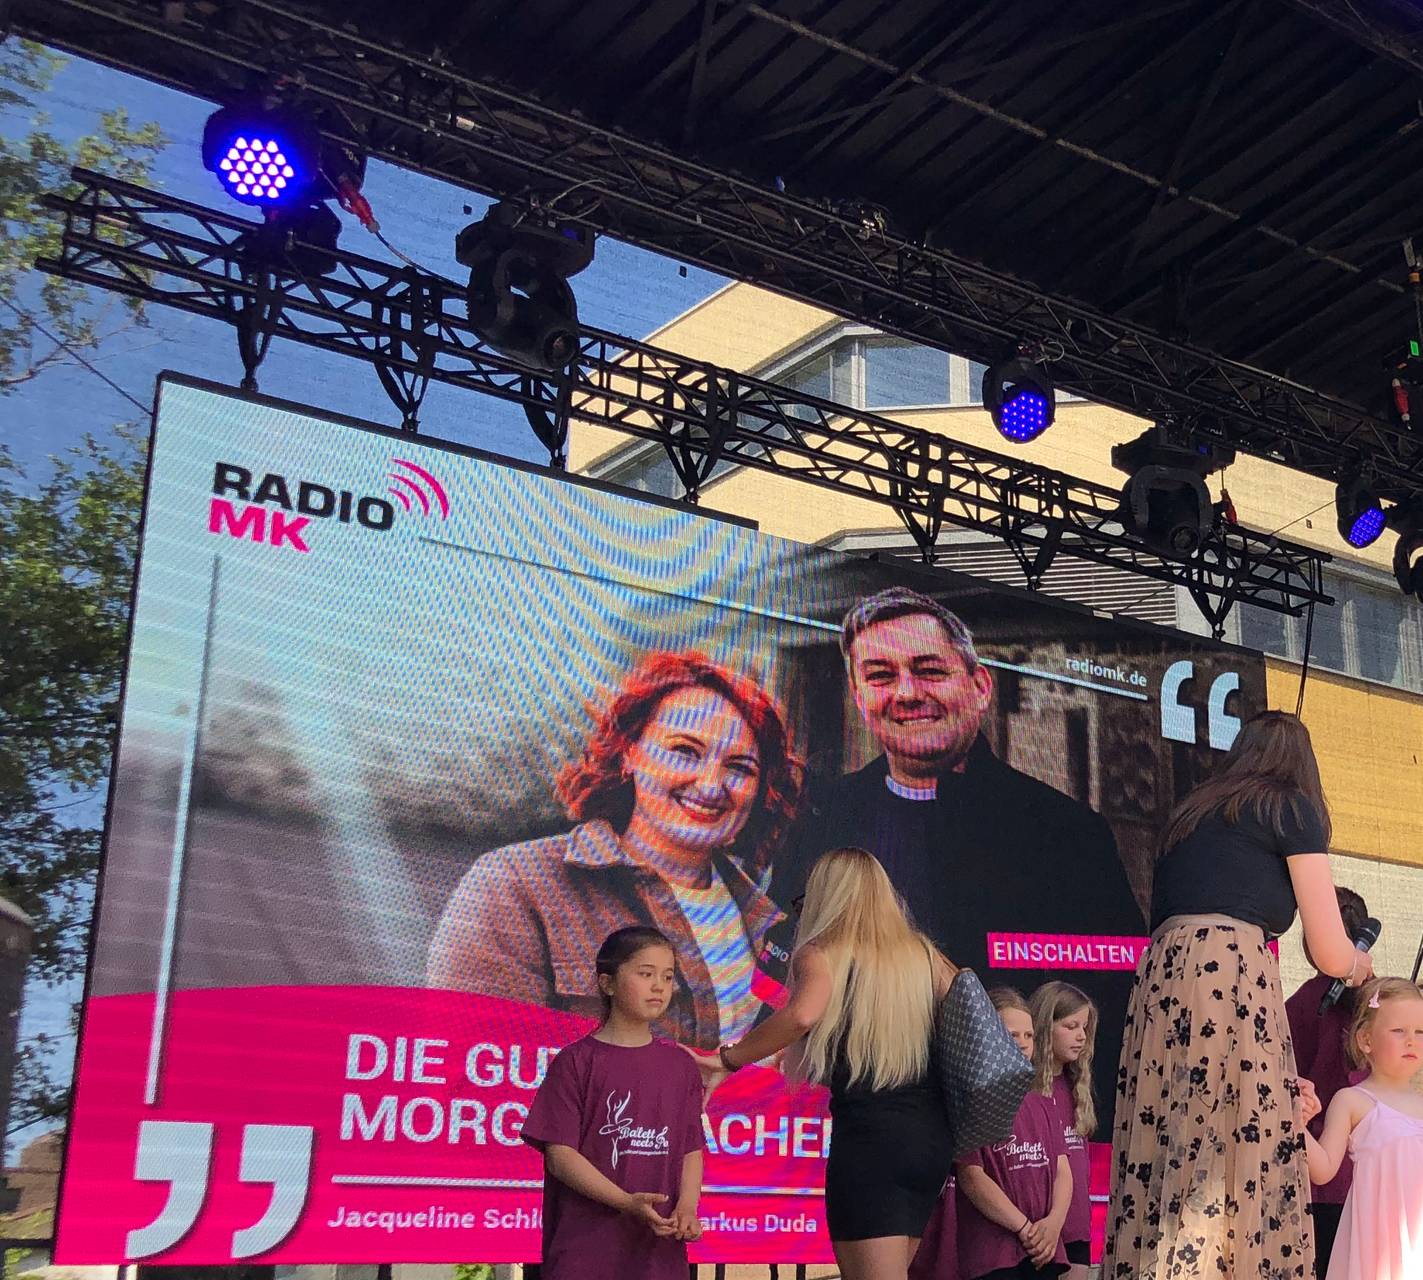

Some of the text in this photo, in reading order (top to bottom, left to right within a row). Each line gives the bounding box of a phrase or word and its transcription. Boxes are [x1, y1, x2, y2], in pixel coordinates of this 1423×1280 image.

[212, 461, 395, 531] RADIO
[208, 497, 311, 554] MK
[1065, 657, 1148, 687] radiomk.de
[993, 941, 1135, 964] EINSCHALTEN
[345, 1033, 562, 1090] DIE GU
[340, 1093, 530, 1146] MORG
[327, 1206, 476, 1233] Jacqueline
[698, 1212, 758, 1232] arkus
[764, 1213, 818, 1233] Duda
